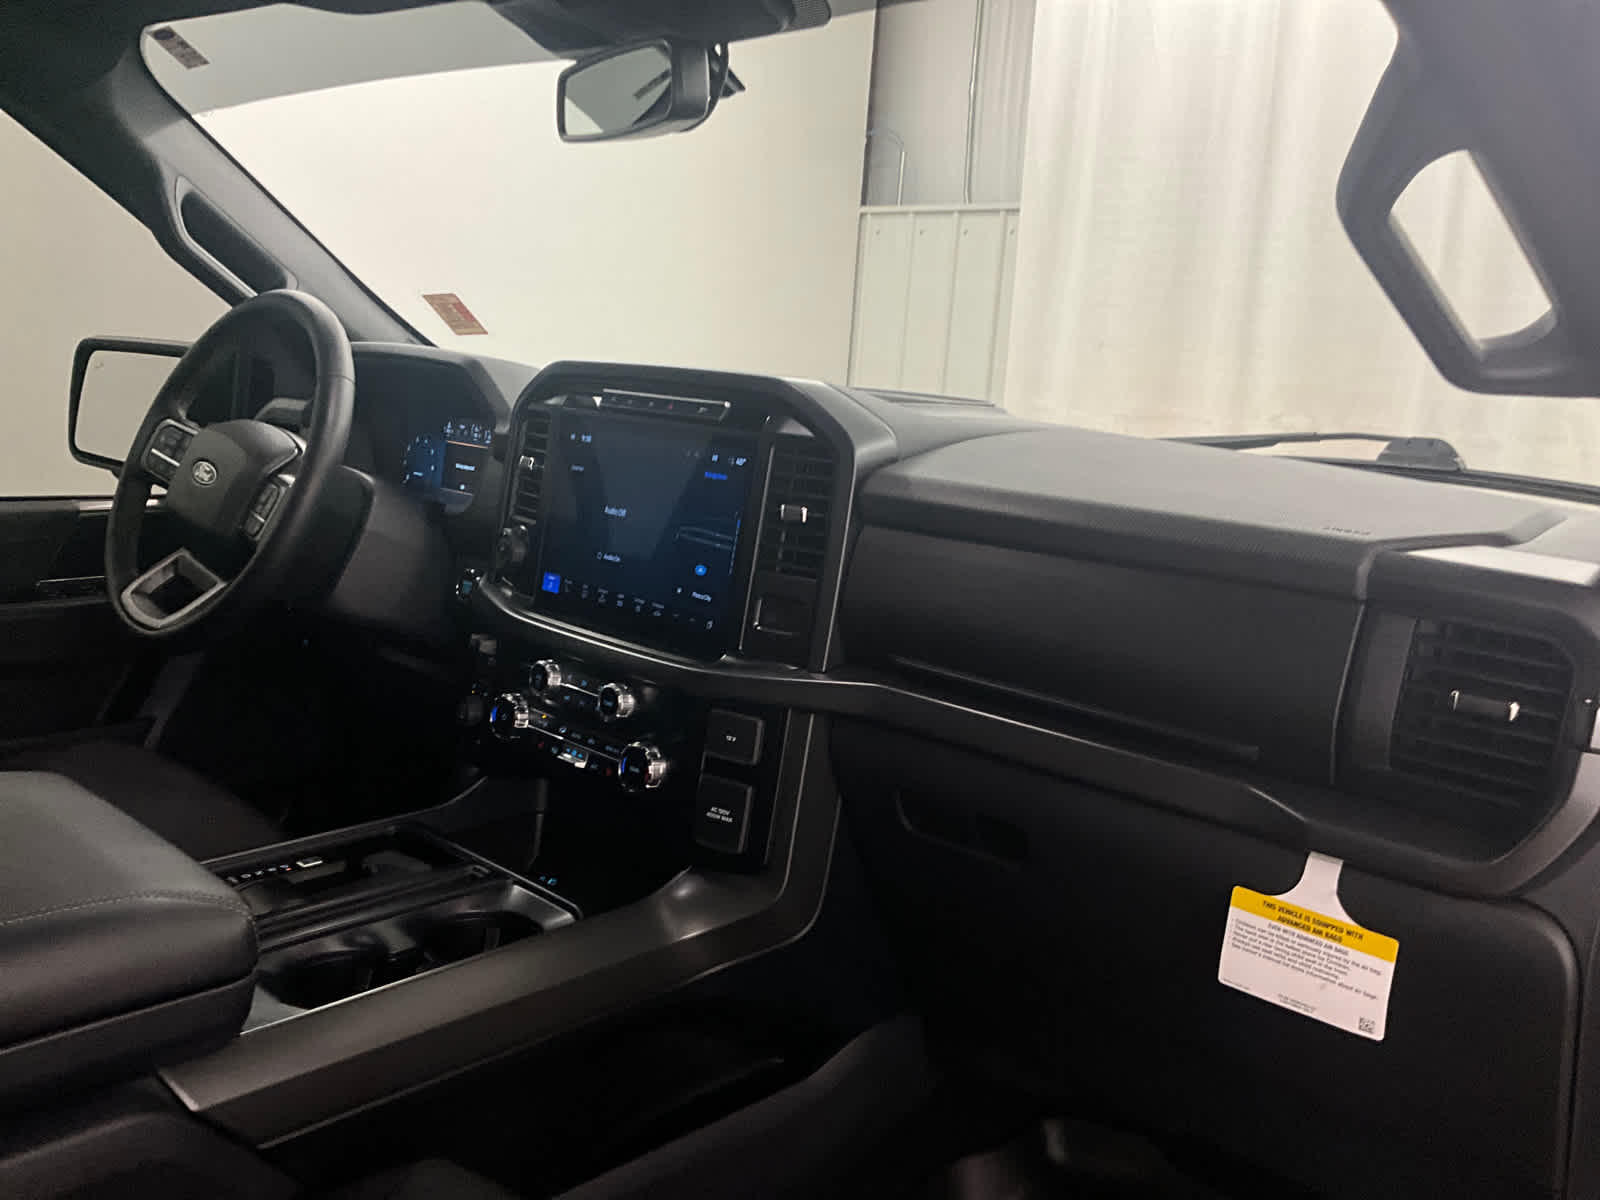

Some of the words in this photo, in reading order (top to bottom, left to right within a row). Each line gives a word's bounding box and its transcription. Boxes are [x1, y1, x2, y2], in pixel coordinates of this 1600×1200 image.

[1263, 901, 1276, 910] THIS
[1278, 906, 1302, 919] VEHICLE
[1312, 918, 1344, 934] EQUIPPED
[1346, 929, 1363, 940] WITH
[1278, 916, 1311, 932] ADVANCED
[1312, 928, 1323, 936] AIR
[1325, 932, 1342, 943] BAGS
